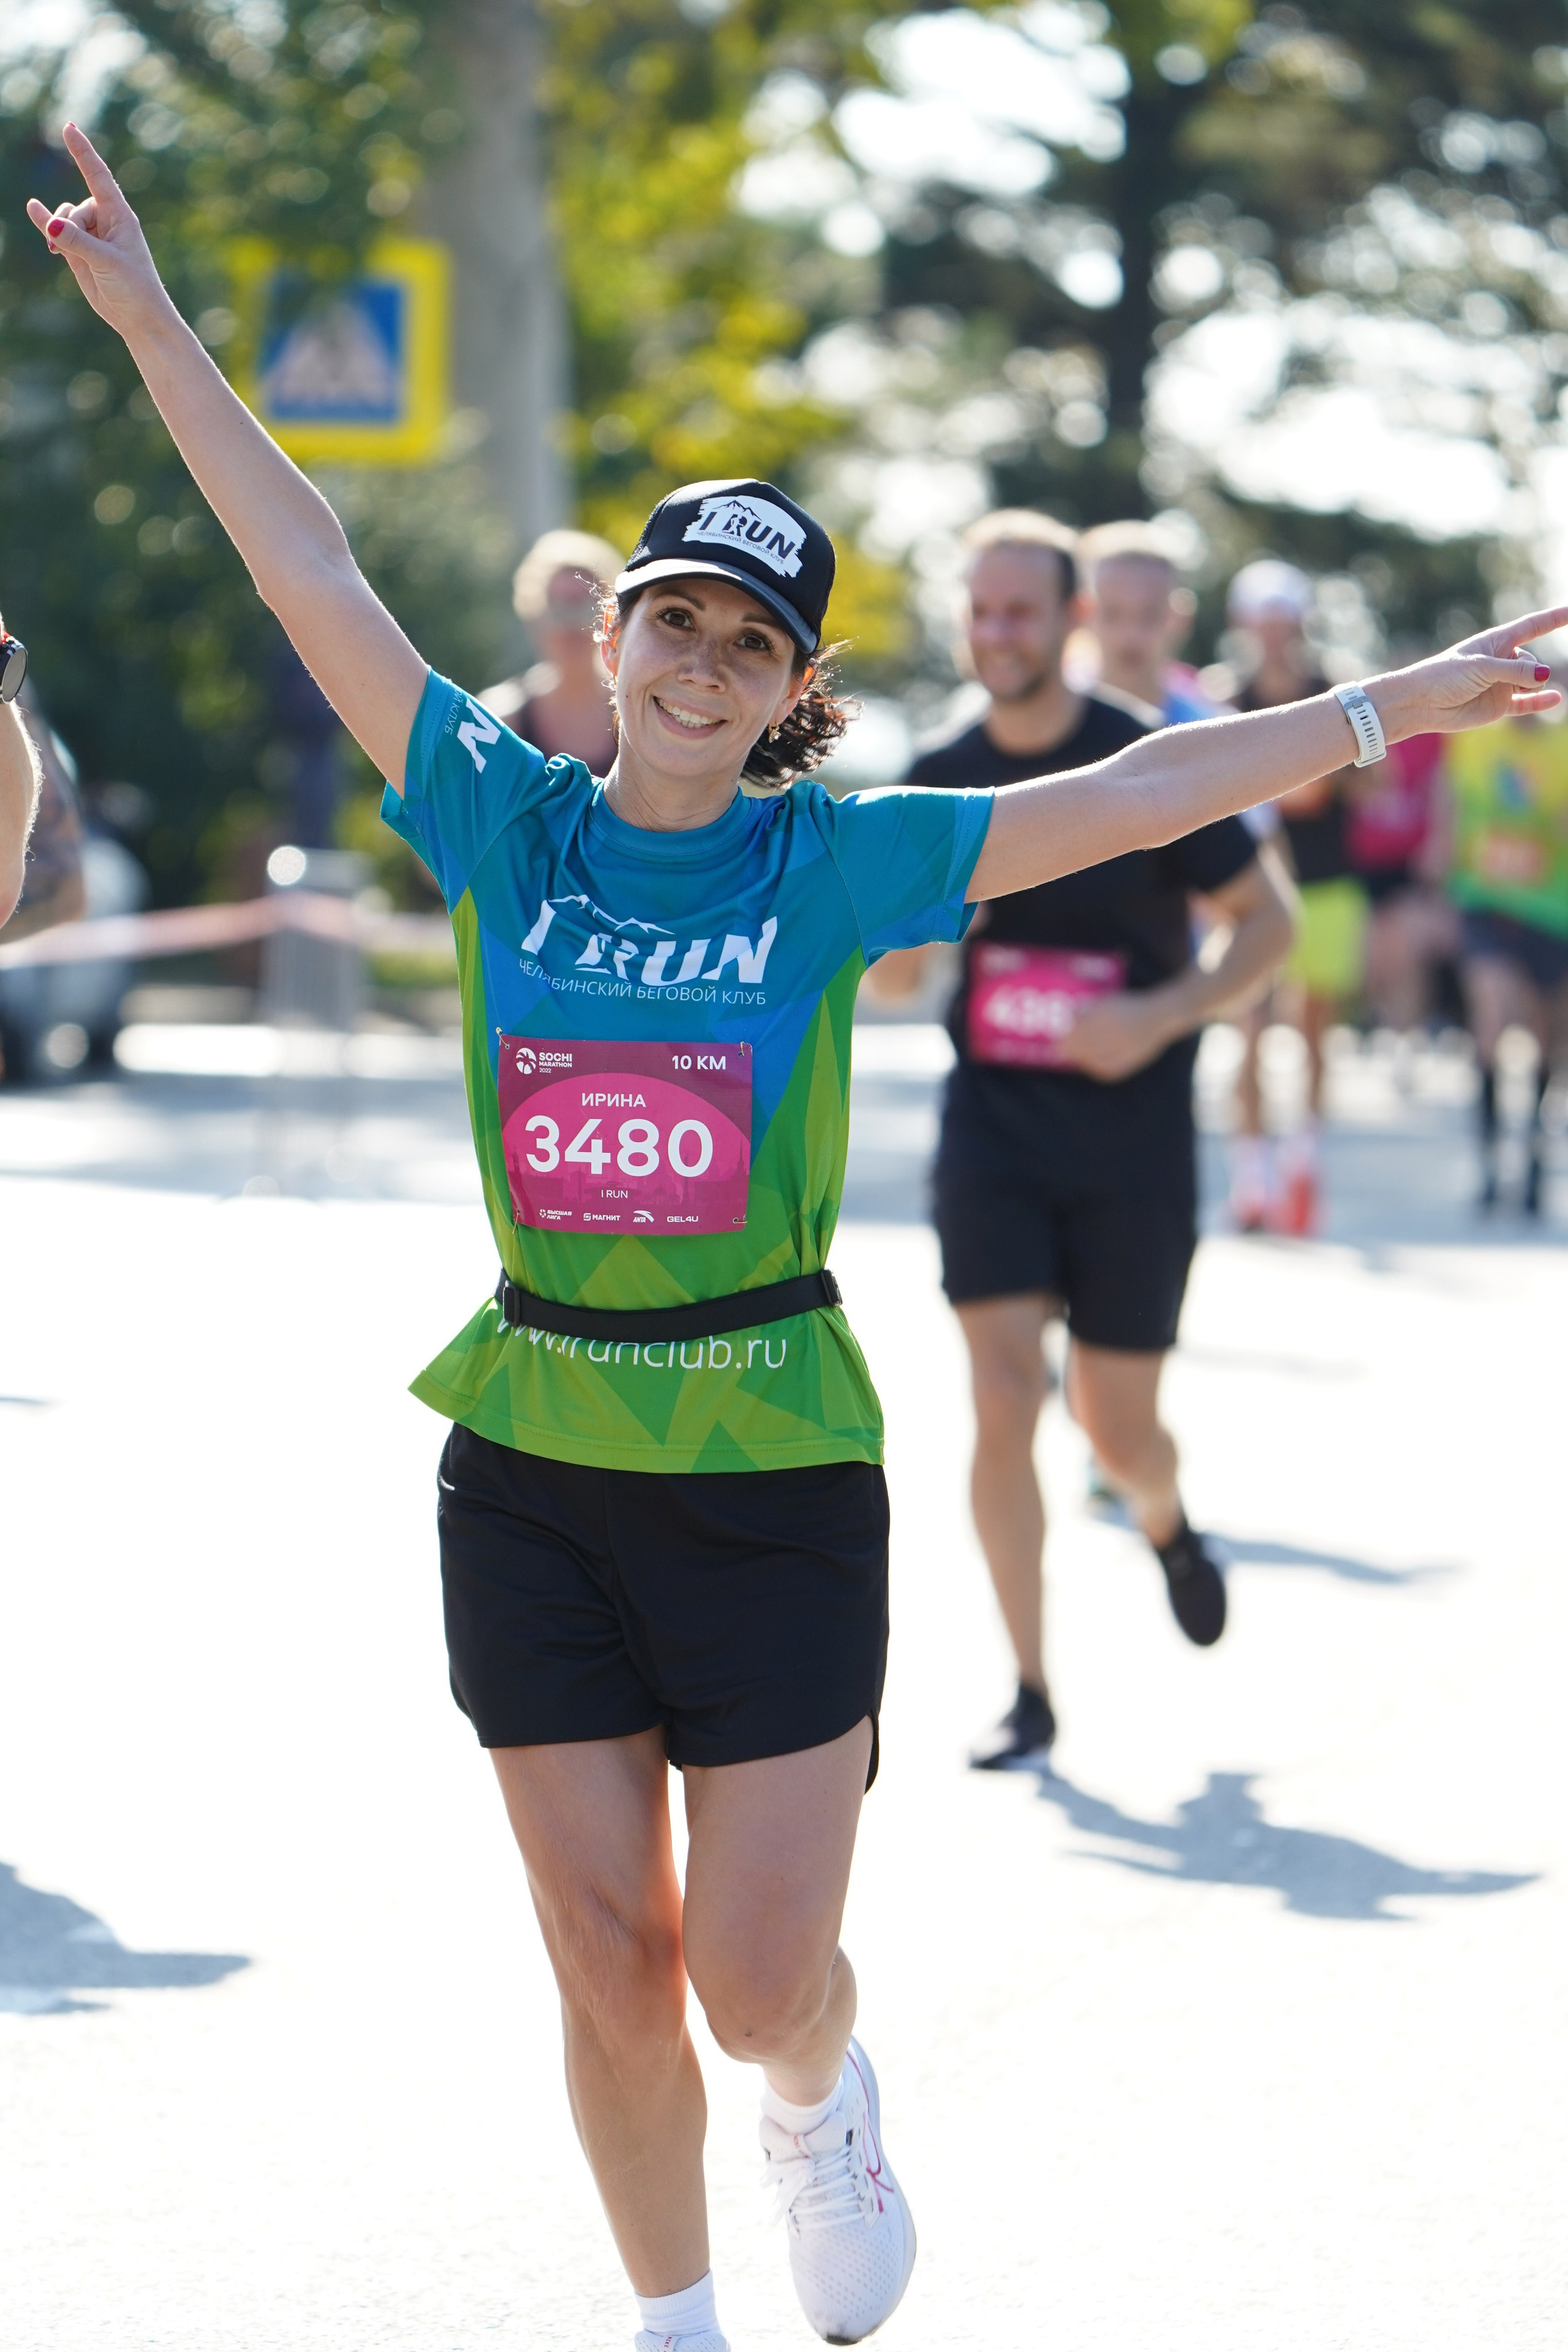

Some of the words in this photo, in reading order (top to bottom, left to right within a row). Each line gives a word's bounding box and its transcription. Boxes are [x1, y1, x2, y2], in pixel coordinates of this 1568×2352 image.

[697, 531, 742, 543] ЧЕЛЯБИНСКИЙ
[742, 540, 770, 556] БЕГОВОЙ
[770, 552, 785, 565] КЛУБ
[699, 511, 718, 530] I
[722, 513, 796, 560] RUN
[521, 899, 557, 956] I
[574, 916, 778, 986] RUN
[519, 958, 632, 998] ЧЕЛЯБИНСКИЙ
[636, 986, 717, 1003] БЕГОВОЙ
[722, 991, 767, 1006] КЛУБ
[538, 1052, 573, 1063] SOCHI
[672, 1055, 692, 1070] 10
[581, 1093, 646, 1108] ИРИНА
[524, 1115, 714, 1178] 3480
[606, 1189, 628, 1199] RUN
